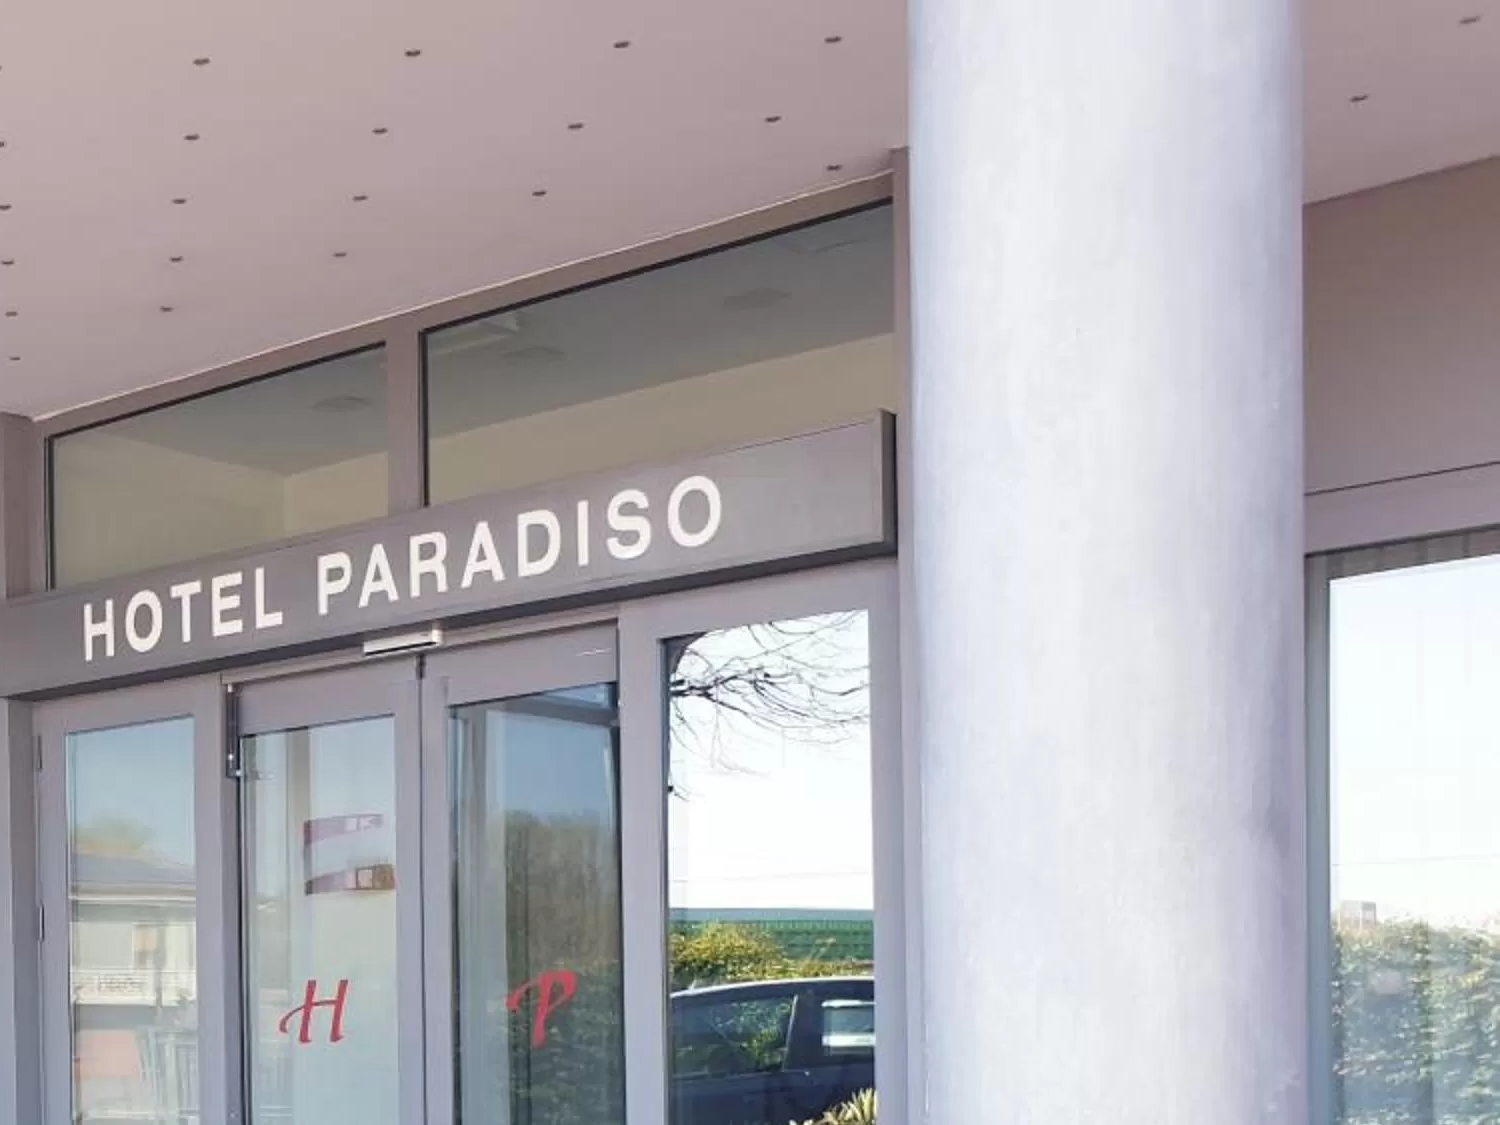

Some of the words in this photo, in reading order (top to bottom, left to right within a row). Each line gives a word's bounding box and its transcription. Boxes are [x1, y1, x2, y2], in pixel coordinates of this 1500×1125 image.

[83, 567, 283, 661] HOTEL
[317, 475, 722, 614] PARADISO
[279, 979, 350, 1042] H
[505, 970, 577, 1047] P
